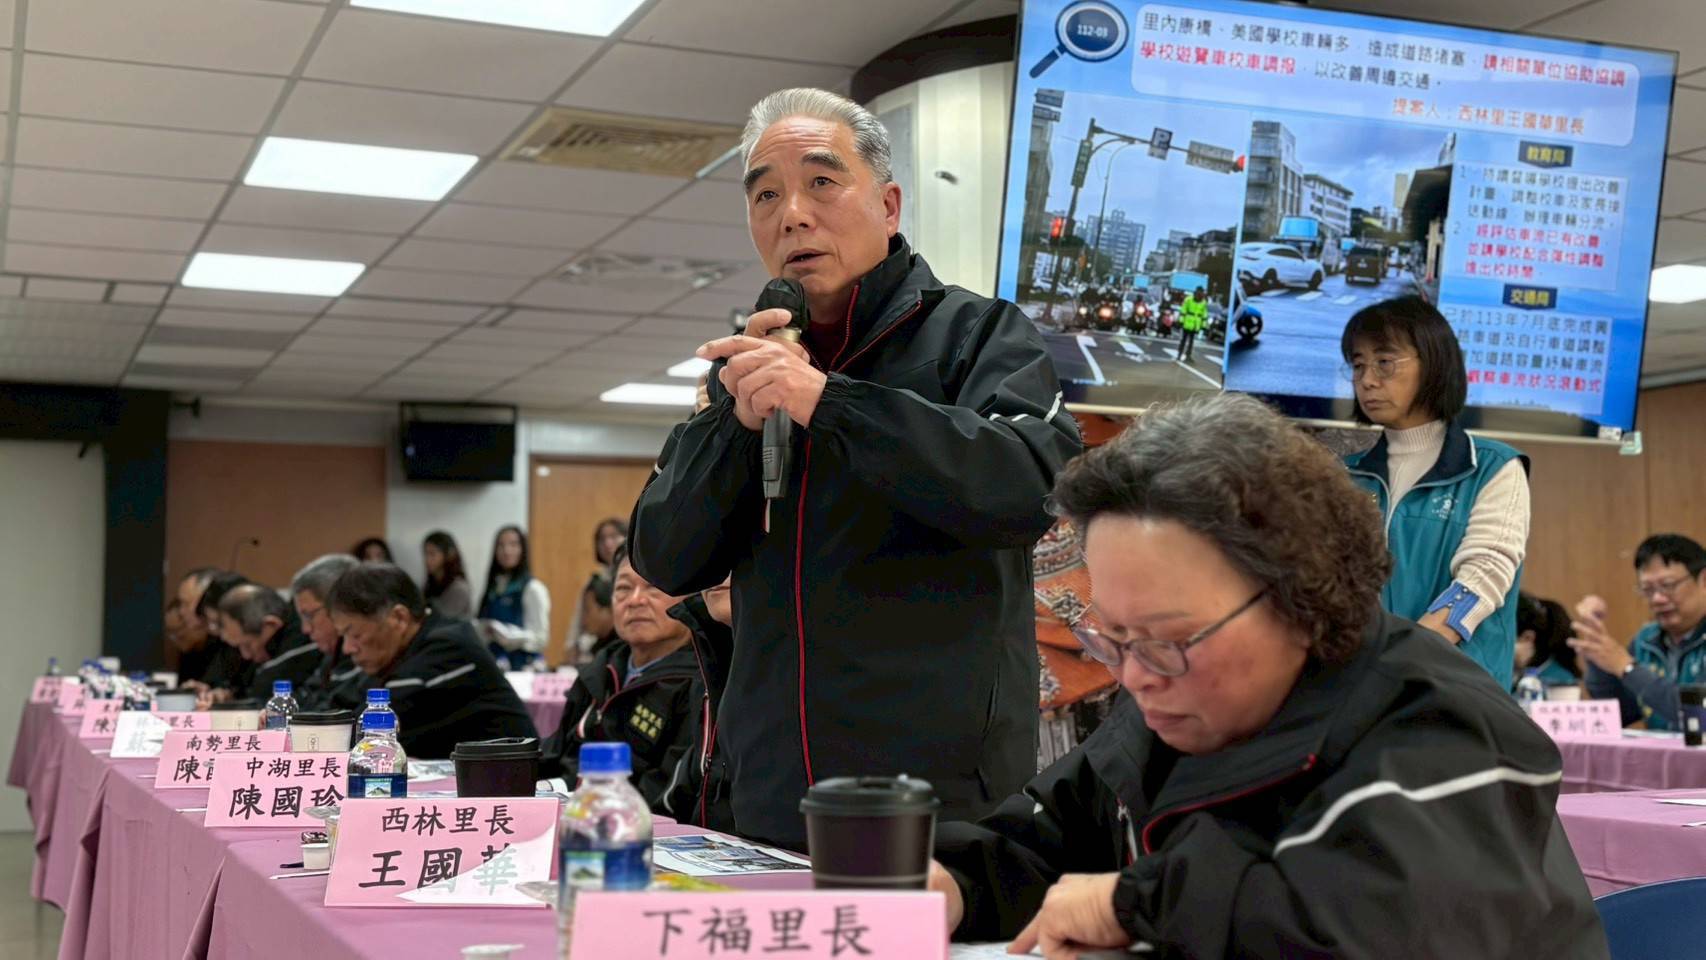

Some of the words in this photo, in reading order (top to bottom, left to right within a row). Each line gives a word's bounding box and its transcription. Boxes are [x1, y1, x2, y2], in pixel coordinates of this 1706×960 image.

[1527, 145, 1566, 165] 教育局
[1510, 288, 1550, 307] 交通局
[187, 734, 262, 752] 南勢里長
[247, 757, 341, 778] 中湖里長
[229, 784, 344, 819] 陳國珍
[382, 804, 514, 836] 西林里長
[358, 842, 518, 896] 王國華
[643, 904, 872, 957] 下福里長
